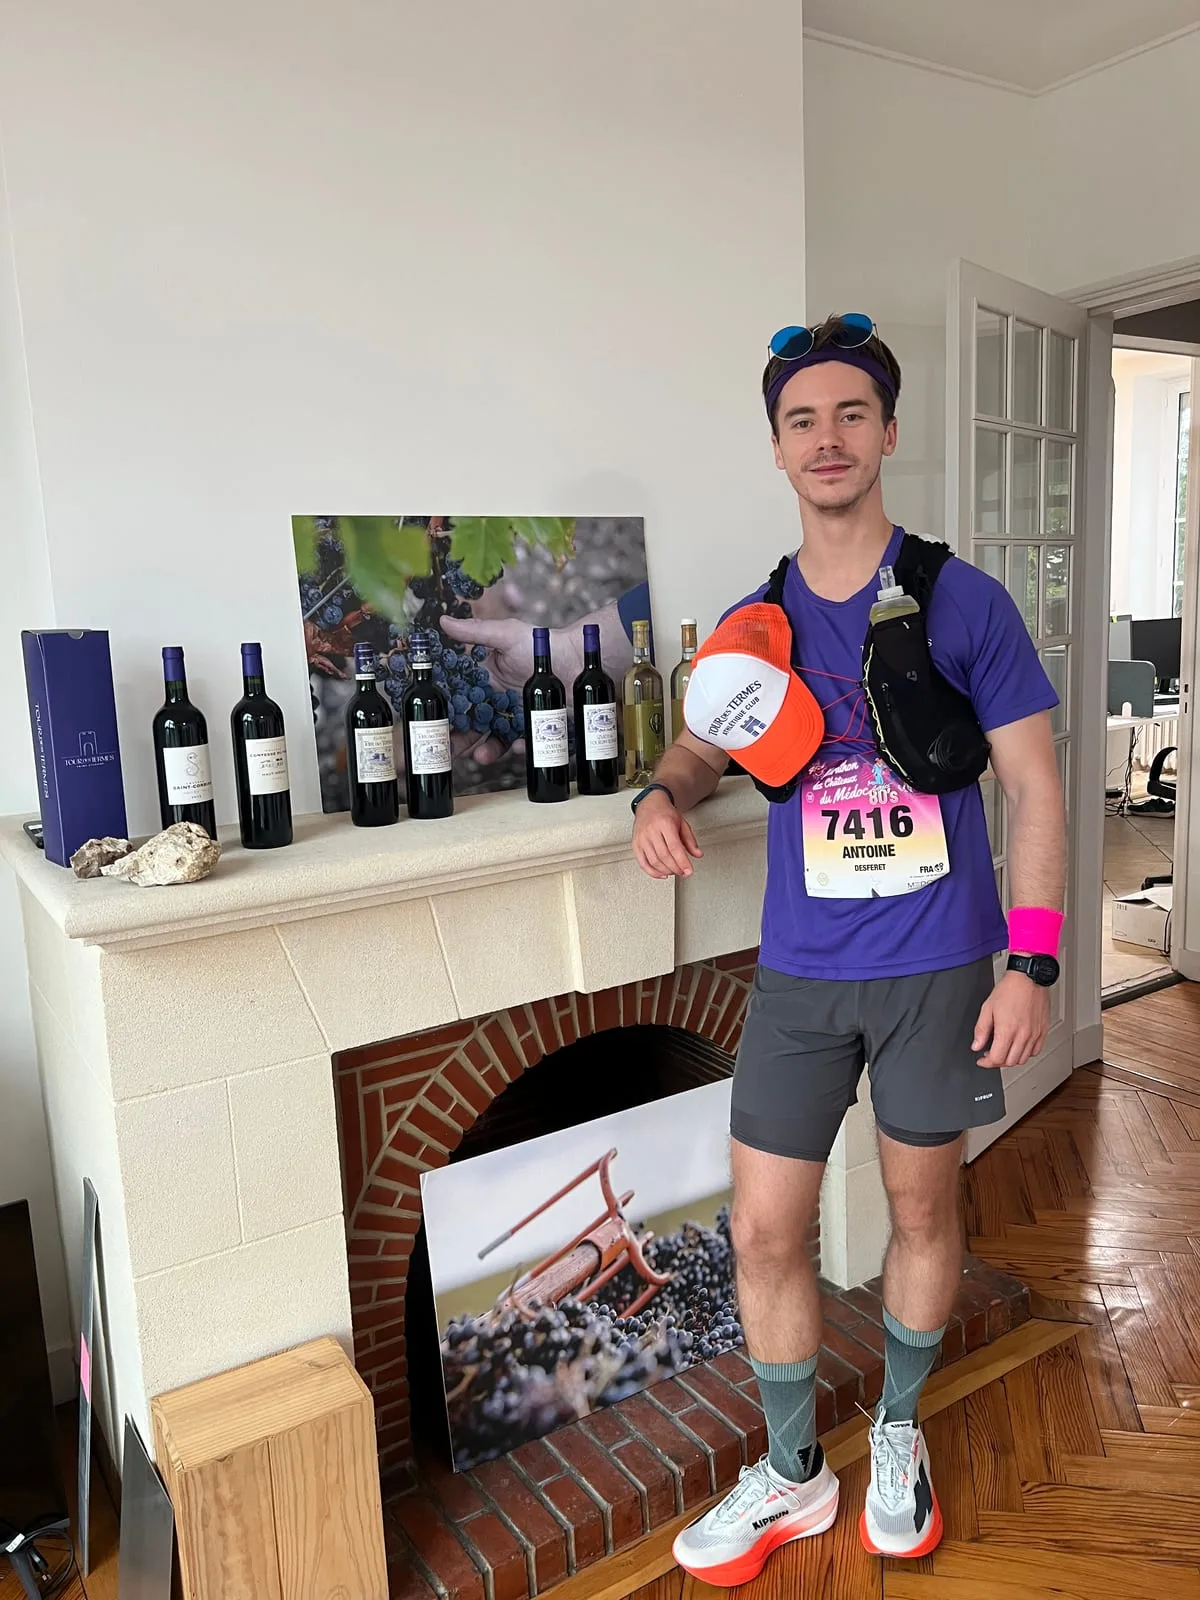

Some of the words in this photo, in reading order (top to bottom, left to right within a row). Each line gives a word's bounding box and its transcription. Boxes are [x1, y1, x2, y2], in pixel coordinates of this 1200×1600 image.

[709, 717, 728, 736] TOUR
[720, 709, 732, 720] DES
[726, 680, 762, 710] TERMES
[744, 696, 760, 711] CLUB
[819, 790, 833, 805] du
[832, 783, 869, 804] Médoc
[869, 787, 899, 806] 80's
[821, 804, 914, 841] 7416
[842, 844, 896, 859] ANTOINE
[854, 863, 886, 872] DESFERET
[919, 865, 934, 874] FRA
[752, 1509, 790, 1531] KIPRUN
